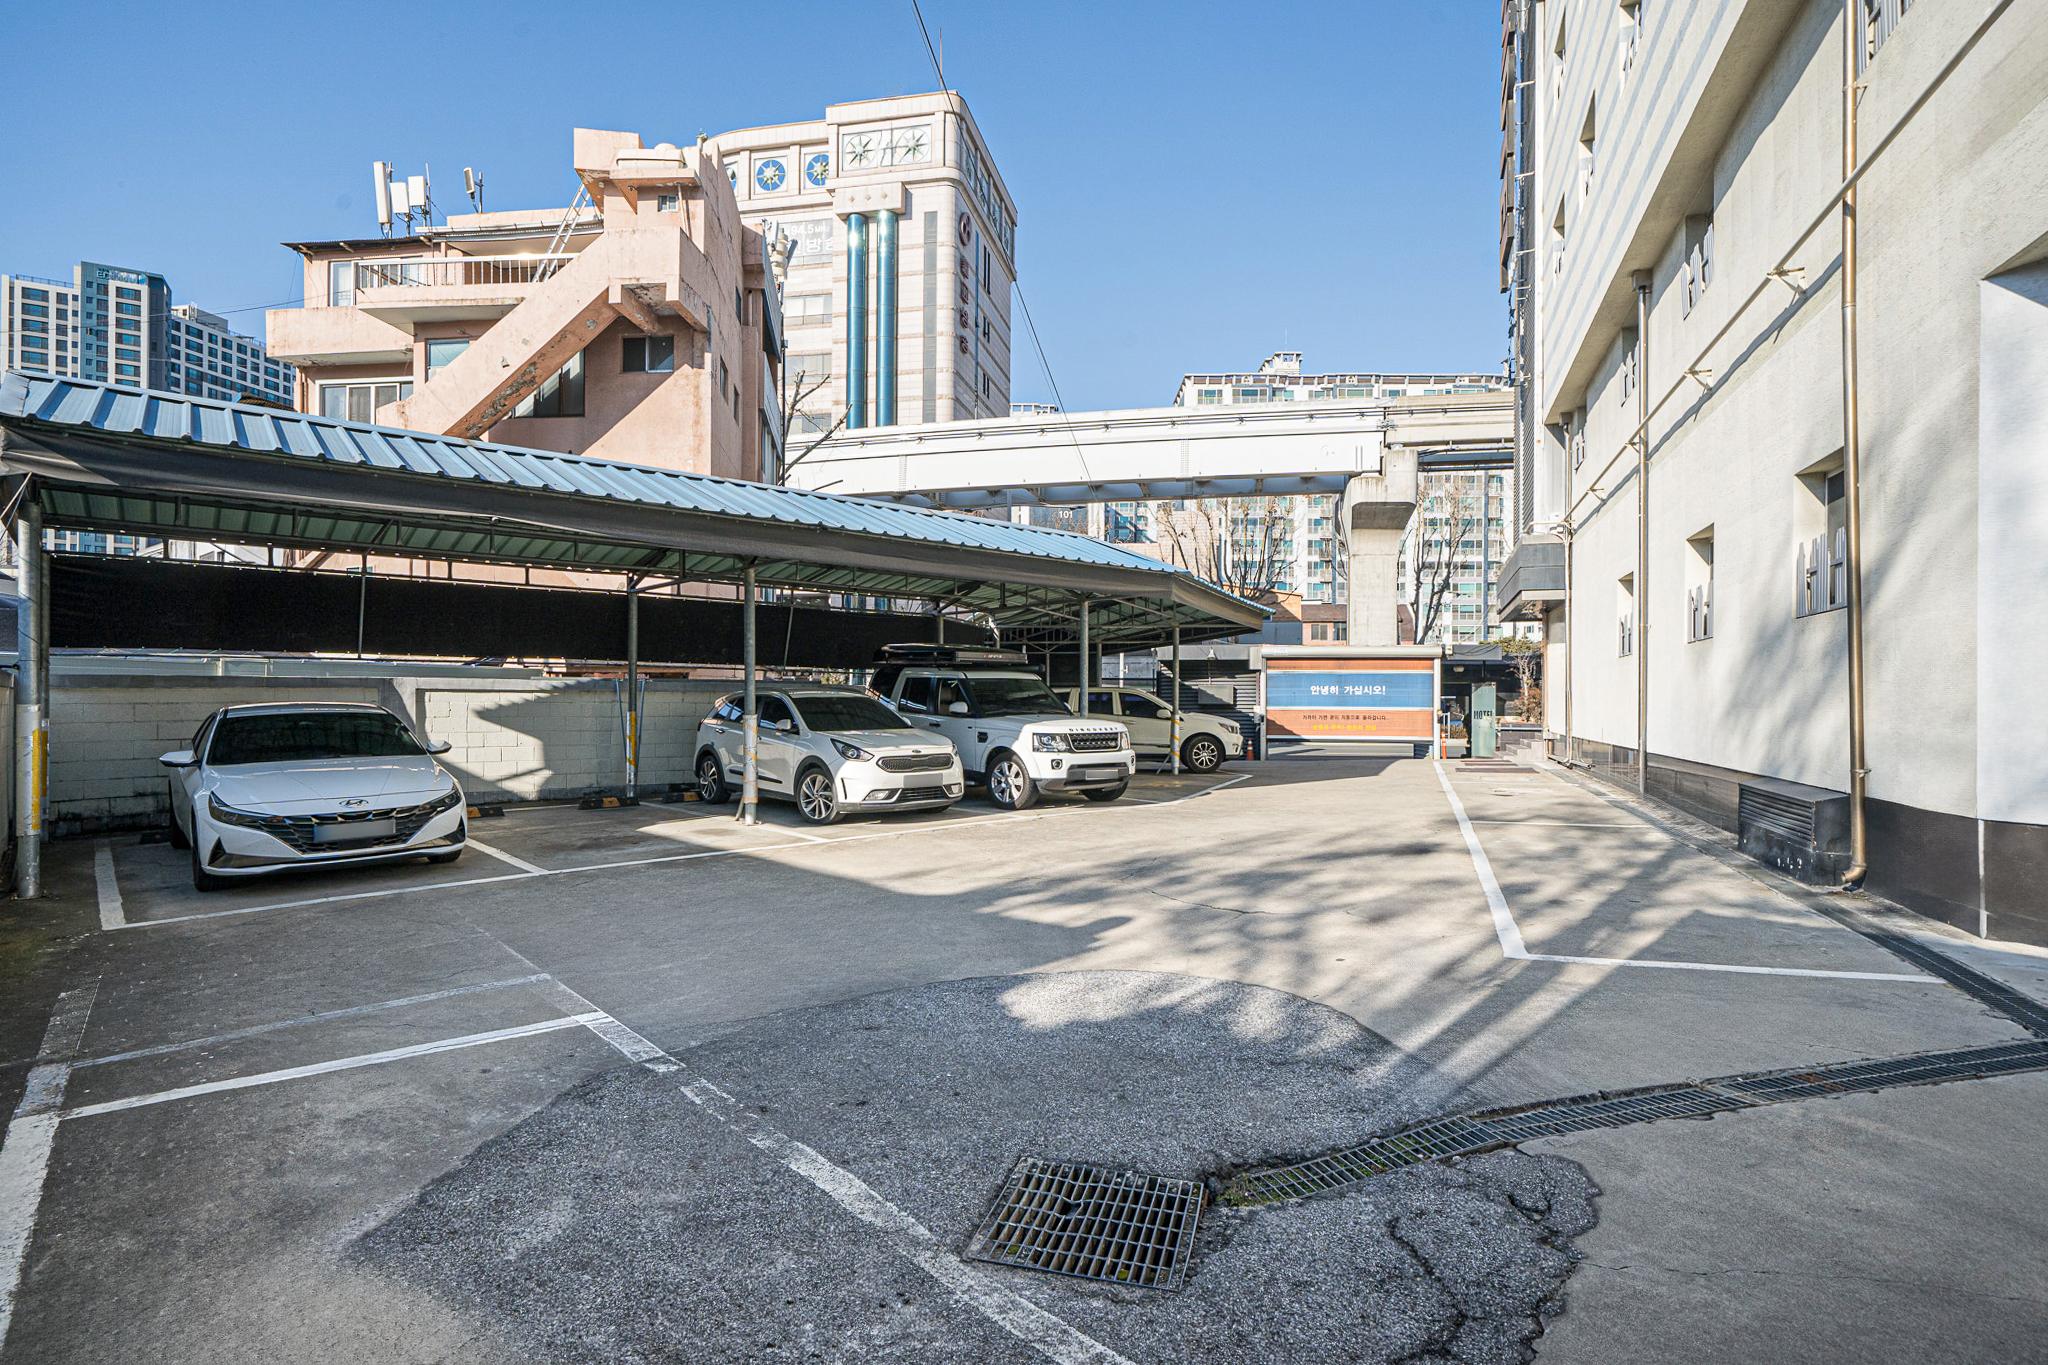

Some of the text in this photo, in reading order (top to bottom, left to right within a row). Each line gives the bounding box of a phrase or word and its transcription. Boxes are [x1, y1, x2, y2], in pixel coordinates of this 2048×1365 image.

[1059, 510, 1073, 519] 101
[1310, 685, 1386, 695] 안녕히 가십시오!
